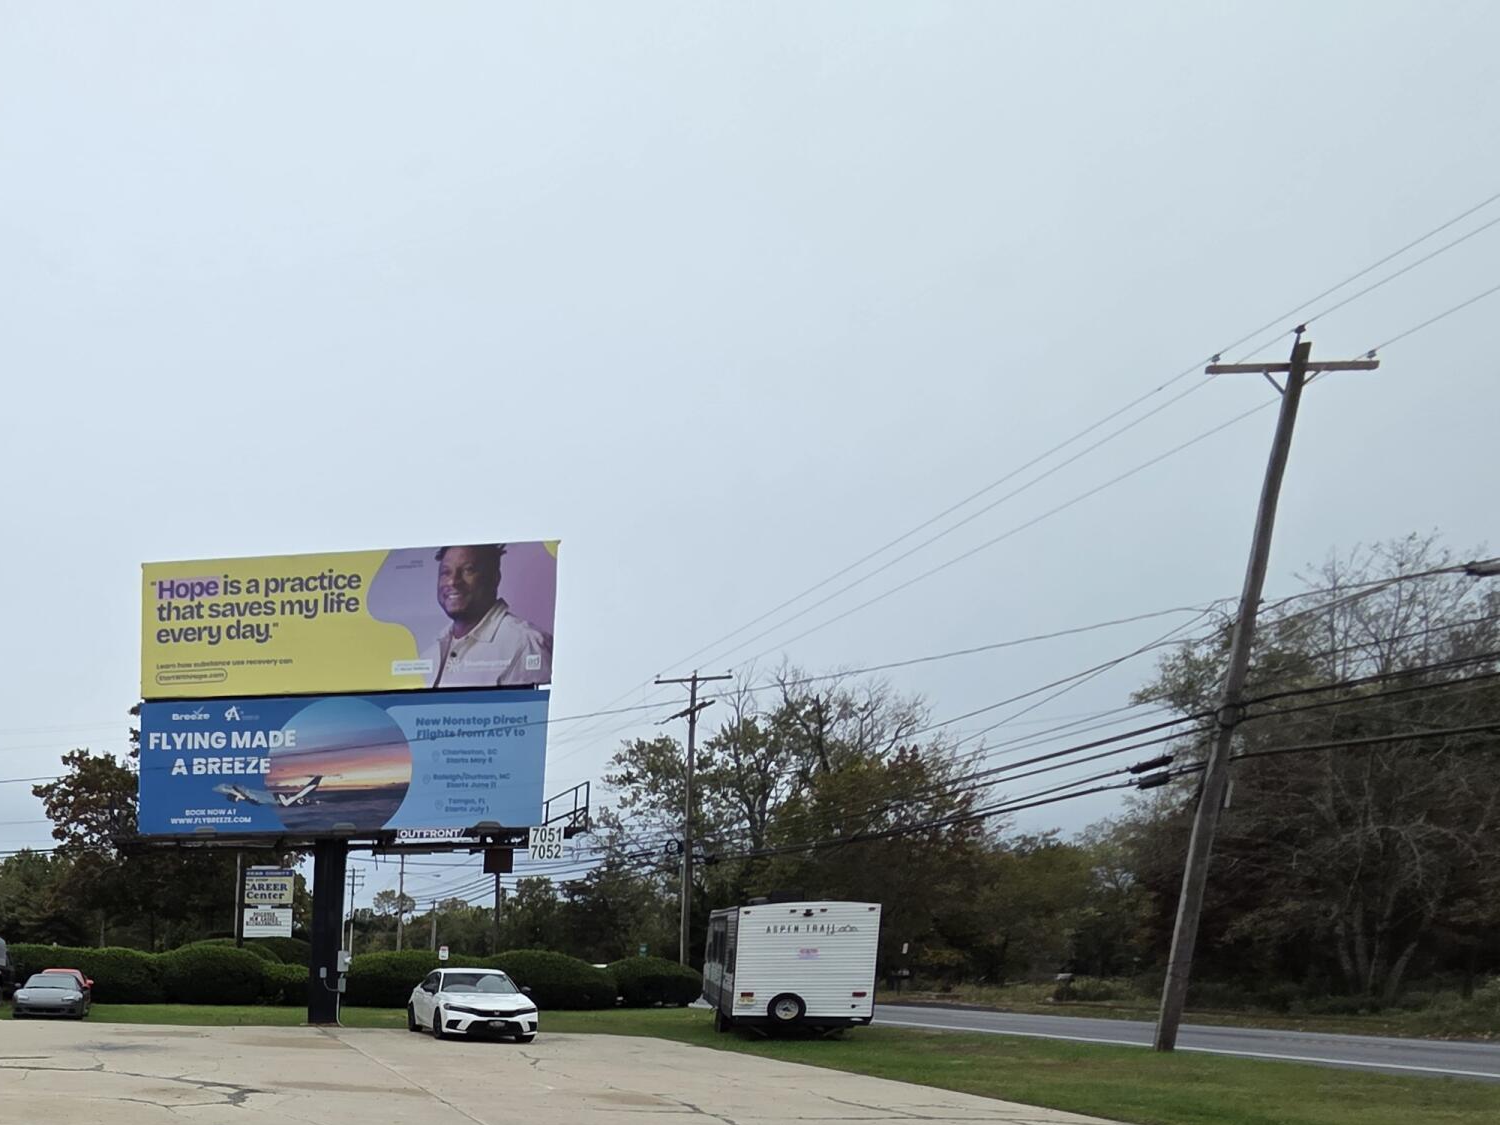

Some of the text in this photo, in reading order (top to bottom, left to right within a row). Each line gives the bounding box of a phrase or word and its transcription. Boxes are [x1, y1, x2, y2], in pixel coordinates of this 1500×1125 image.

[223, 574, 242, 596] is
[246, 579, 260, 595] a
[264, 568, 362, 598] practice
[157, 592, 360, 622] that saves my life
[156, 625, 222, 645] every
[193, 659, 230, 668] substance
[246, 658, 277, 667] recovery
[172, 710, 210, 721] Breeze
[415, 714, 528, 728] New Nonstop Direct
[149, 729, 297, 750] FLYING MADE
[416, 728, 526, 741] Flights from ACY to
[171, 757, 272, 775] A BREEZE
[470, 757, 488, 765] May
[185, 809, 206, 817] BOOK
[207, 808, 226, 816] NOW
[532, 828, 562, 843] 7051
[531, 844, 562, 860] 7052
[246, 891, 285, 900] Center
